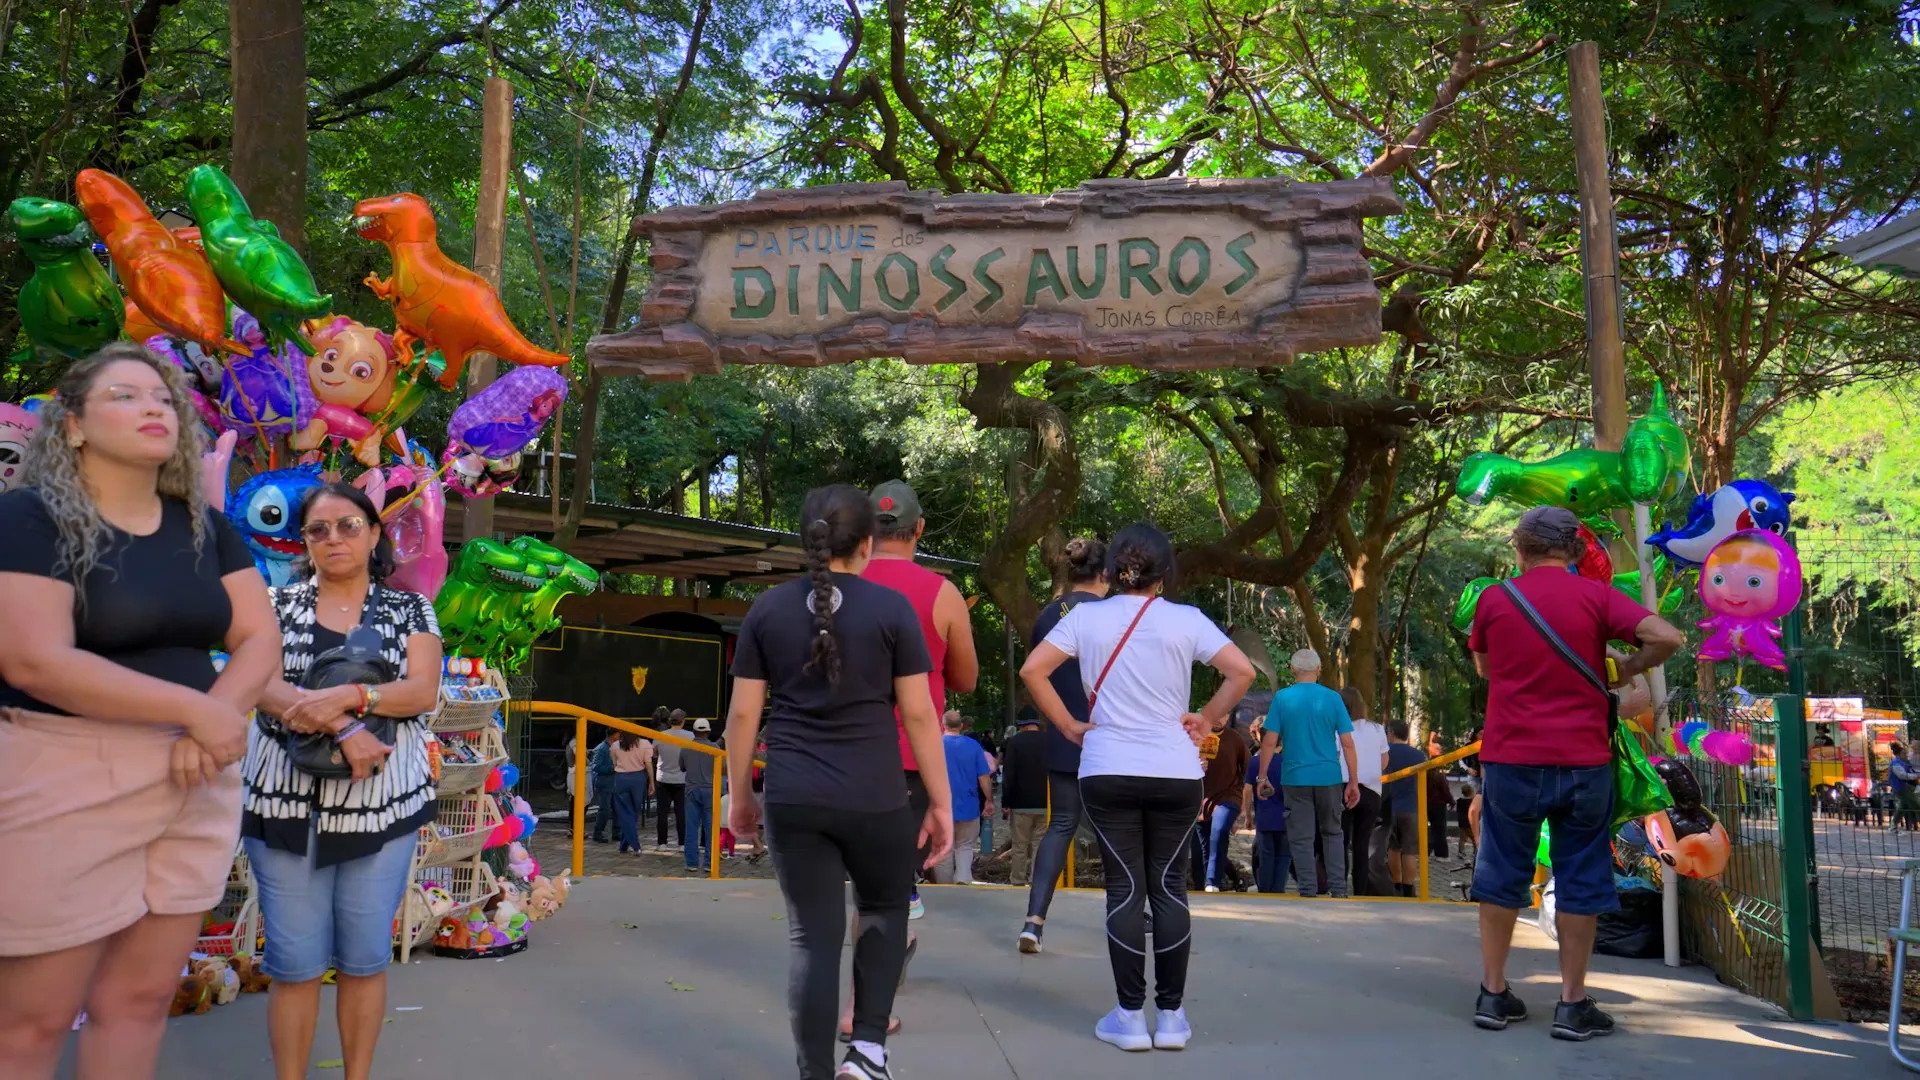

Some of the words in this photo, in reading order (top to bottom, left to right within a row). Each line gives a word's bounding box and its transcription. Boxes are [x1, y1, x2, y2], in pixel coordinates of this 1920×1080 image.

[735, 224, 877, 258] PARQUE
[891, 228, 925, 248] dos
[730, 231, 1260, 319] DINOSSAUROS
[1096, 307, 1156, 328] JONAS
